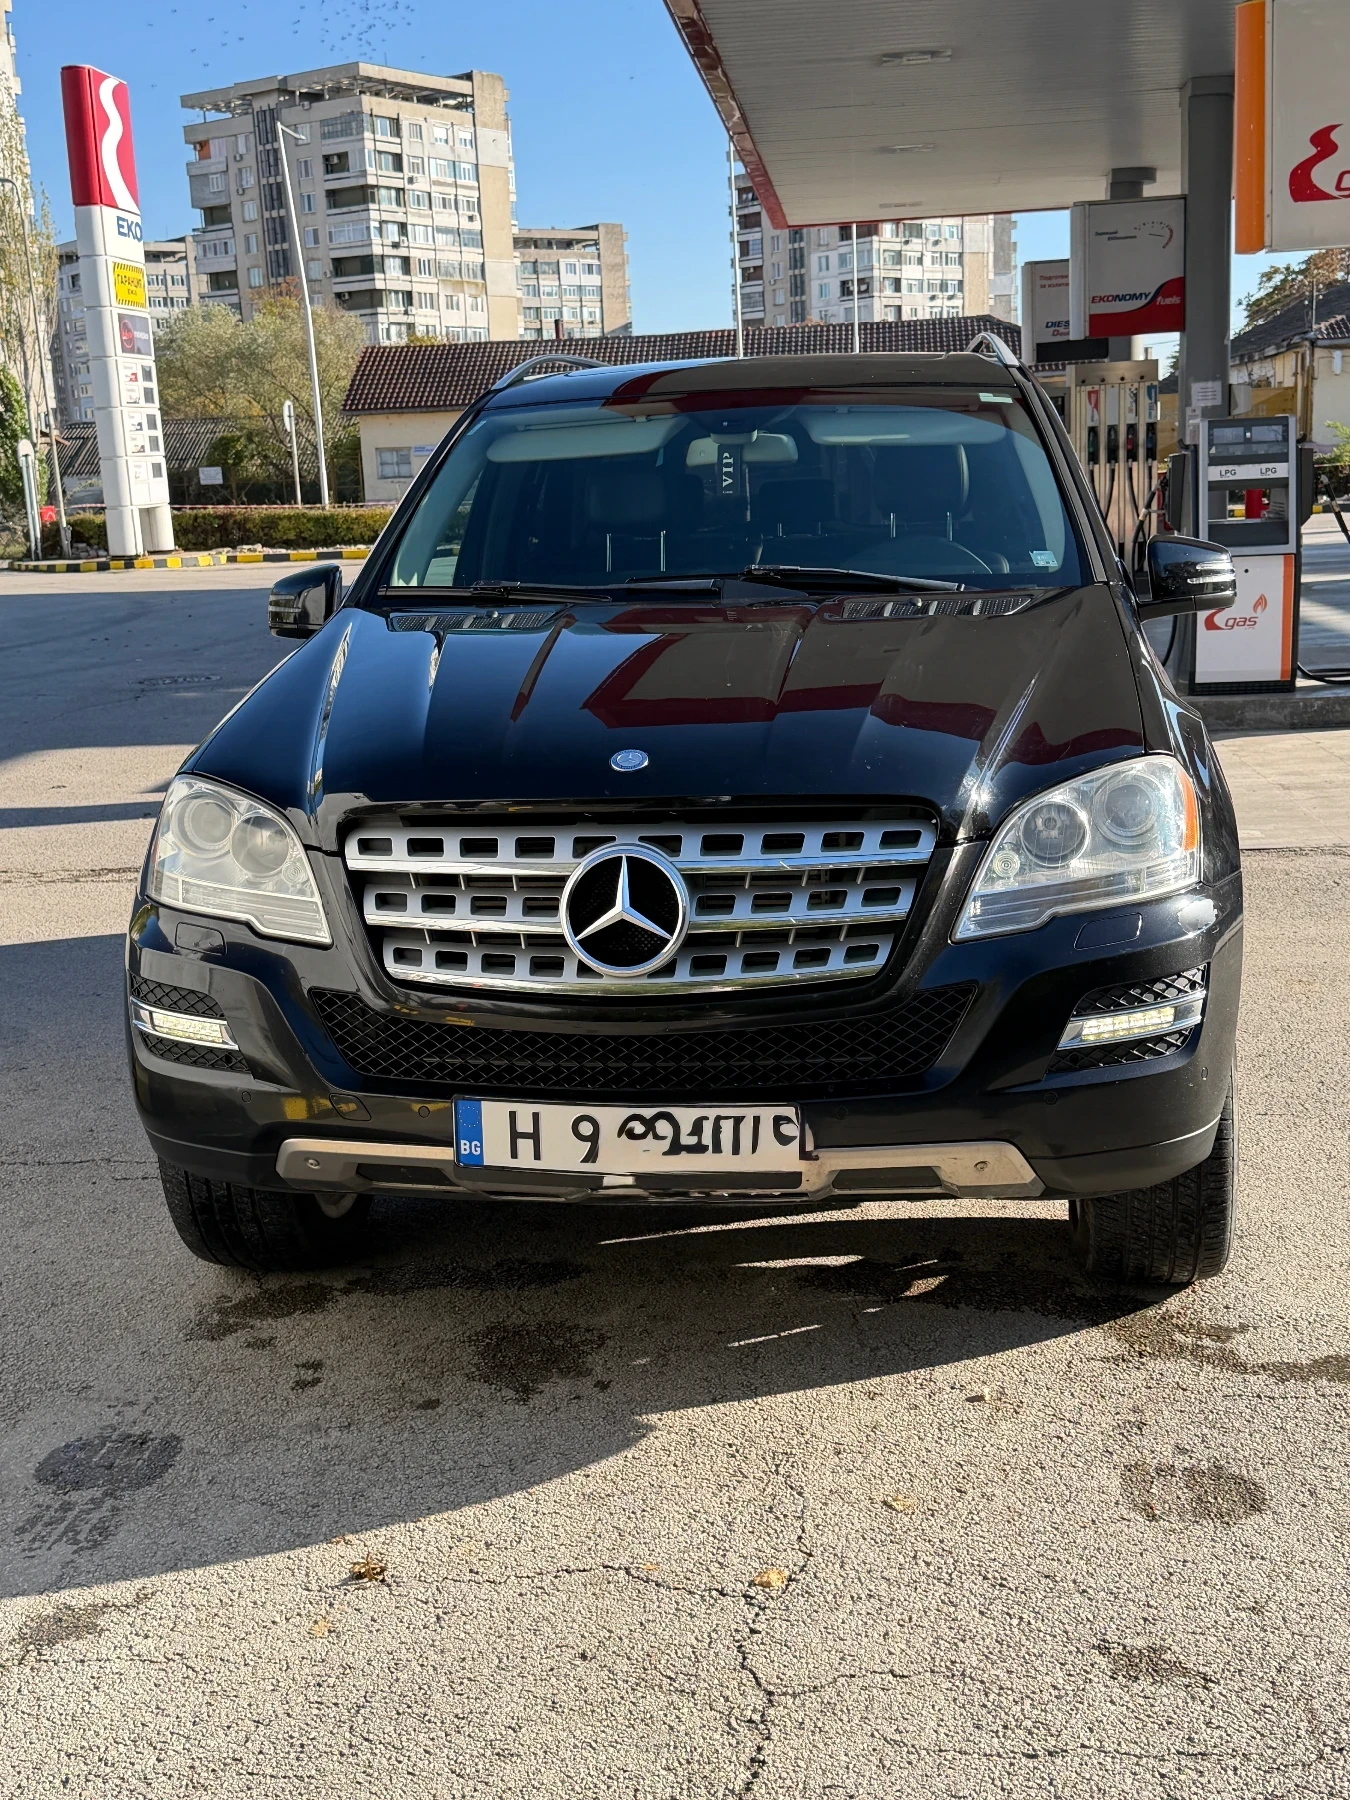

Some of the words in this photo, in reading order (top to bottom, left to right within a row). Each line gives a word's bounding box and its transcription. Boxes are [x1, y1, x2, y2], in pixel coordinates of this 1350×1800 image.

[116, 215, 143, 243] EKO
[1091, 292, 1152, 304] EKONOMY
[1156, 295, 1181, 306] fuels
[1045, 319, 1071, 329] DIES
[722, 452, 734, 488] VIP
[1219, 469, 1237, 477] LPG
[1260, 467, 1278, 475] LPG
[1224, 616, 1259, 631] gas
[460, 1140, 481, 1155] BG
